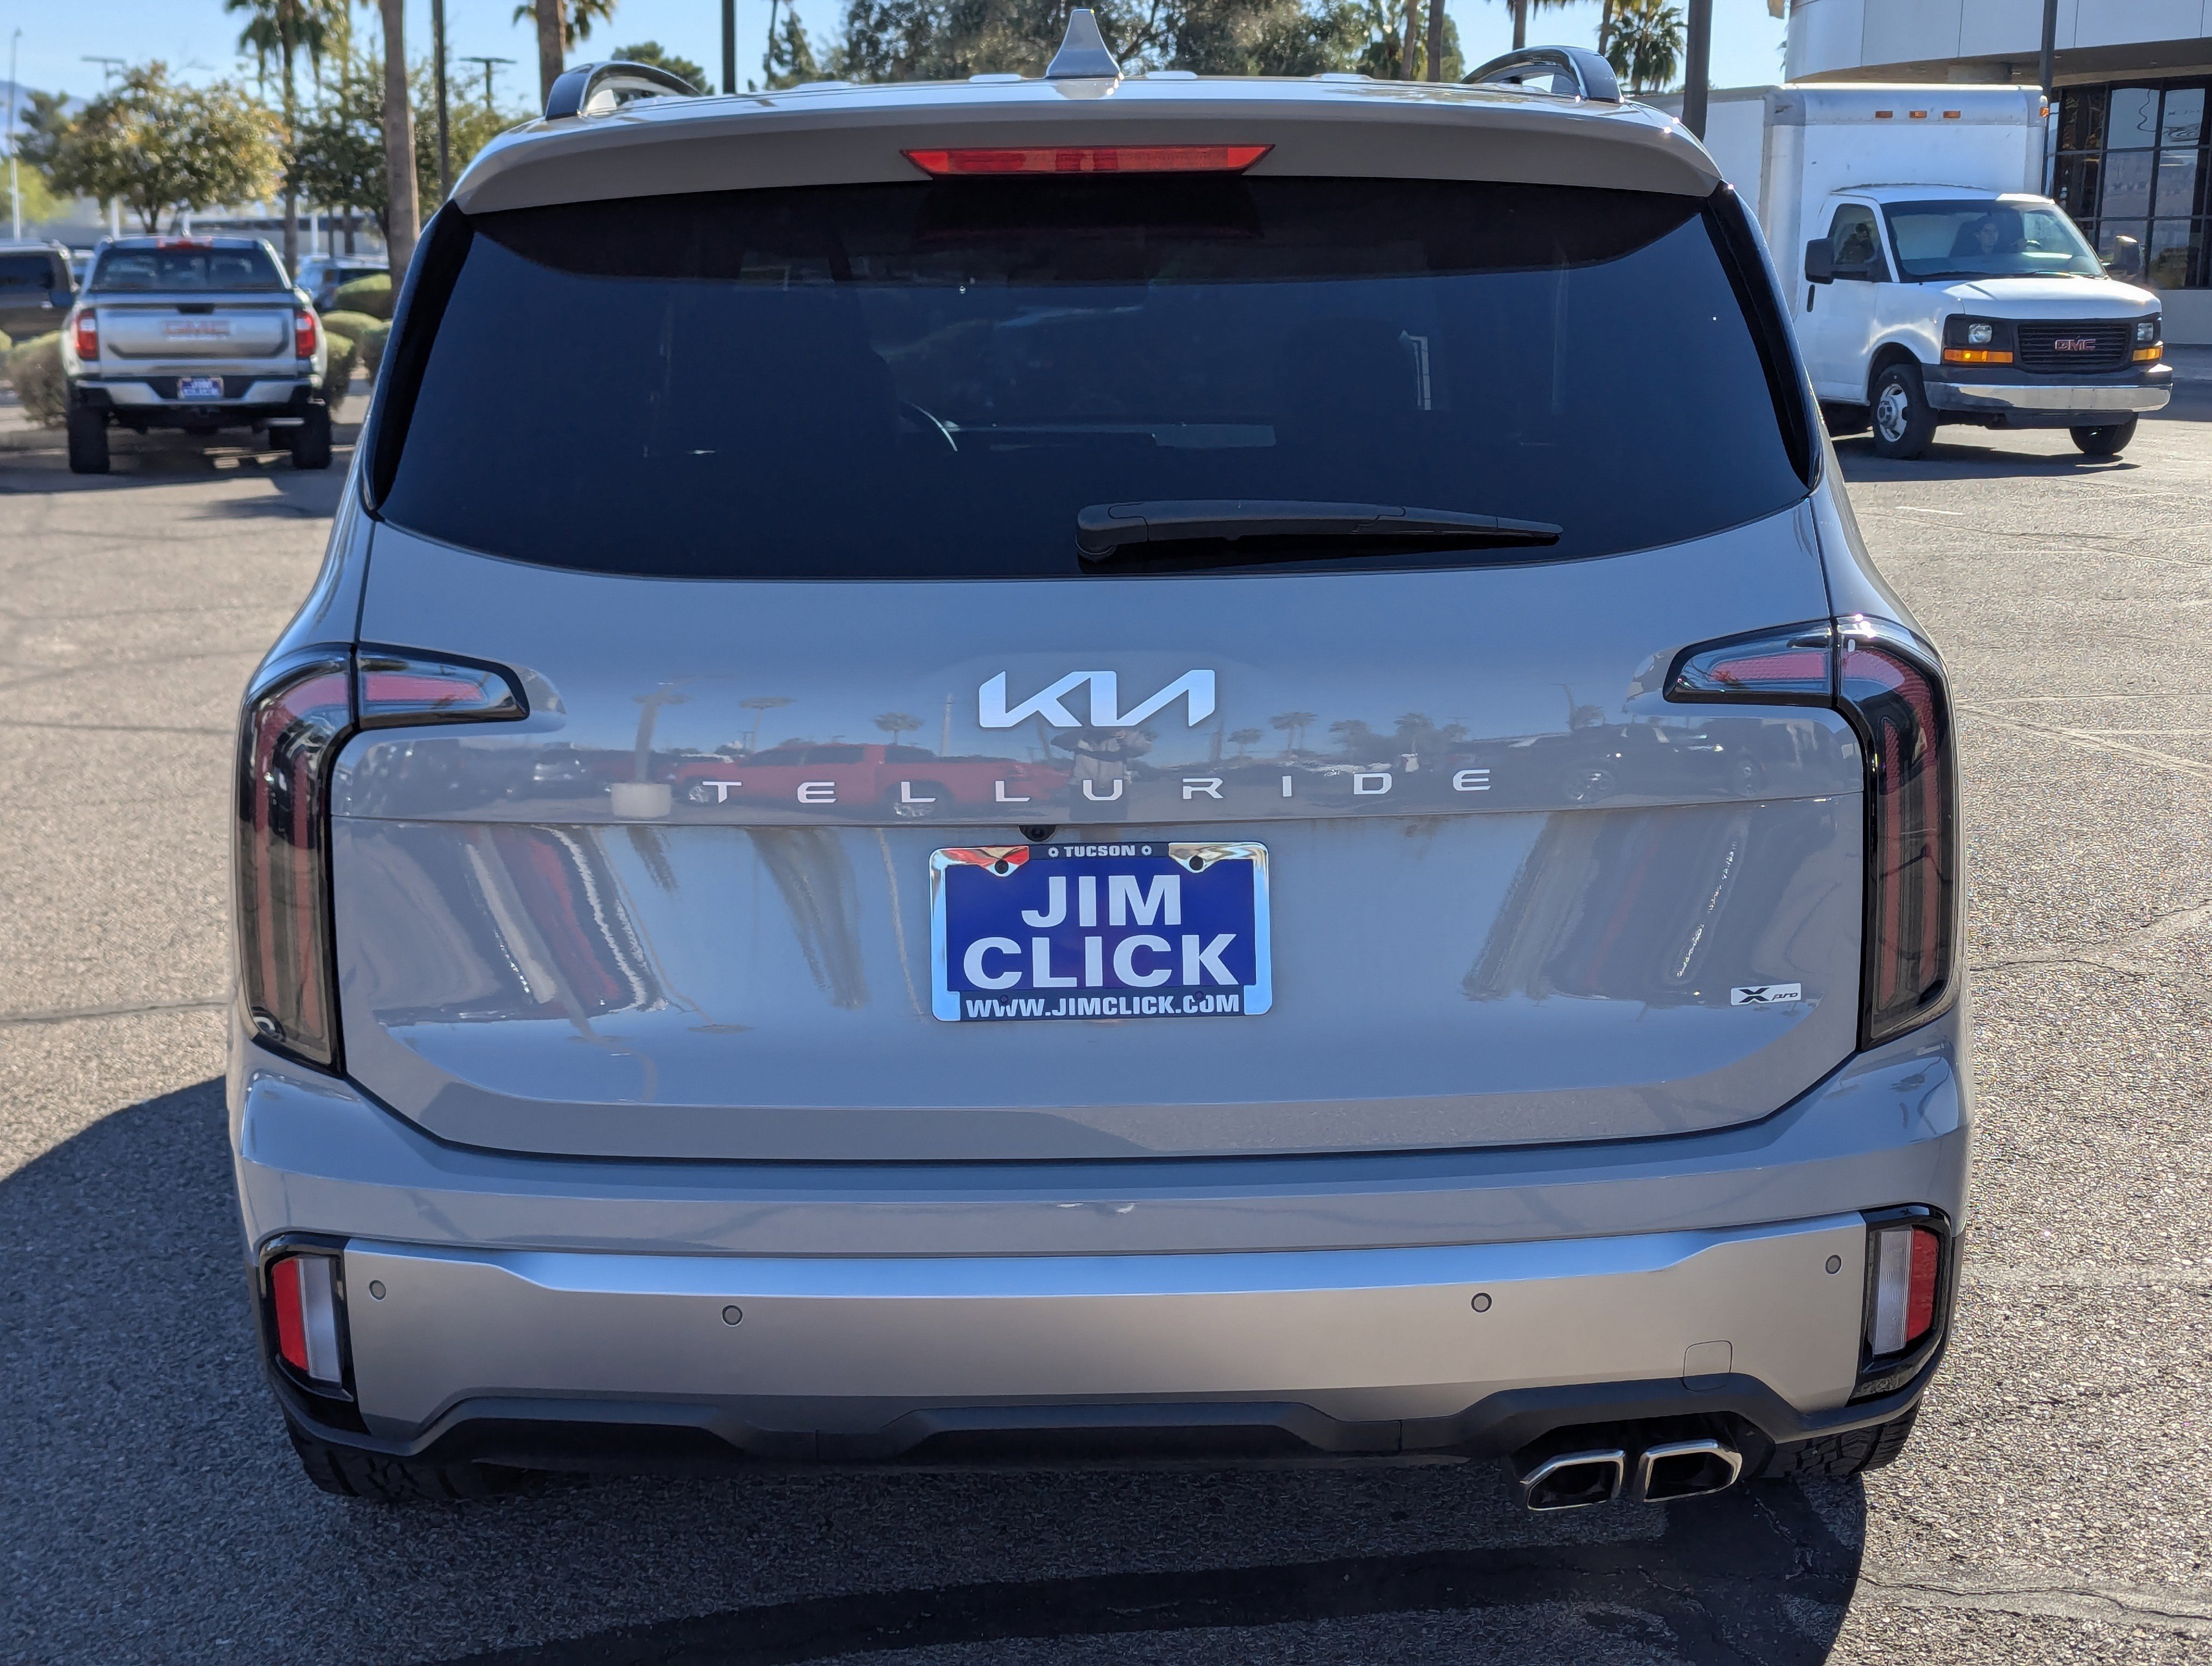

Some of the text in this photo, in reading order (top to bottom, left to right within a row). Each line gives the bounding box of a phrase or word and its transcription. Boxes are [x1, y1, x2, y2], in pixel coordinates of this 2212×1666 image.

[2055, 339, 2097, 351] GMC
[979, 669, 1216, 728] KIA
[702, 768, 1491, 804] TELLURIDE
[1064, 845, 1136, 858] TUCSON
[1021, 874, 1182, 928] JIM
[963, 933, 1239, 989] CLICK
[966, 994, 1240, 1018] WWW.JIMCLICK.COM
